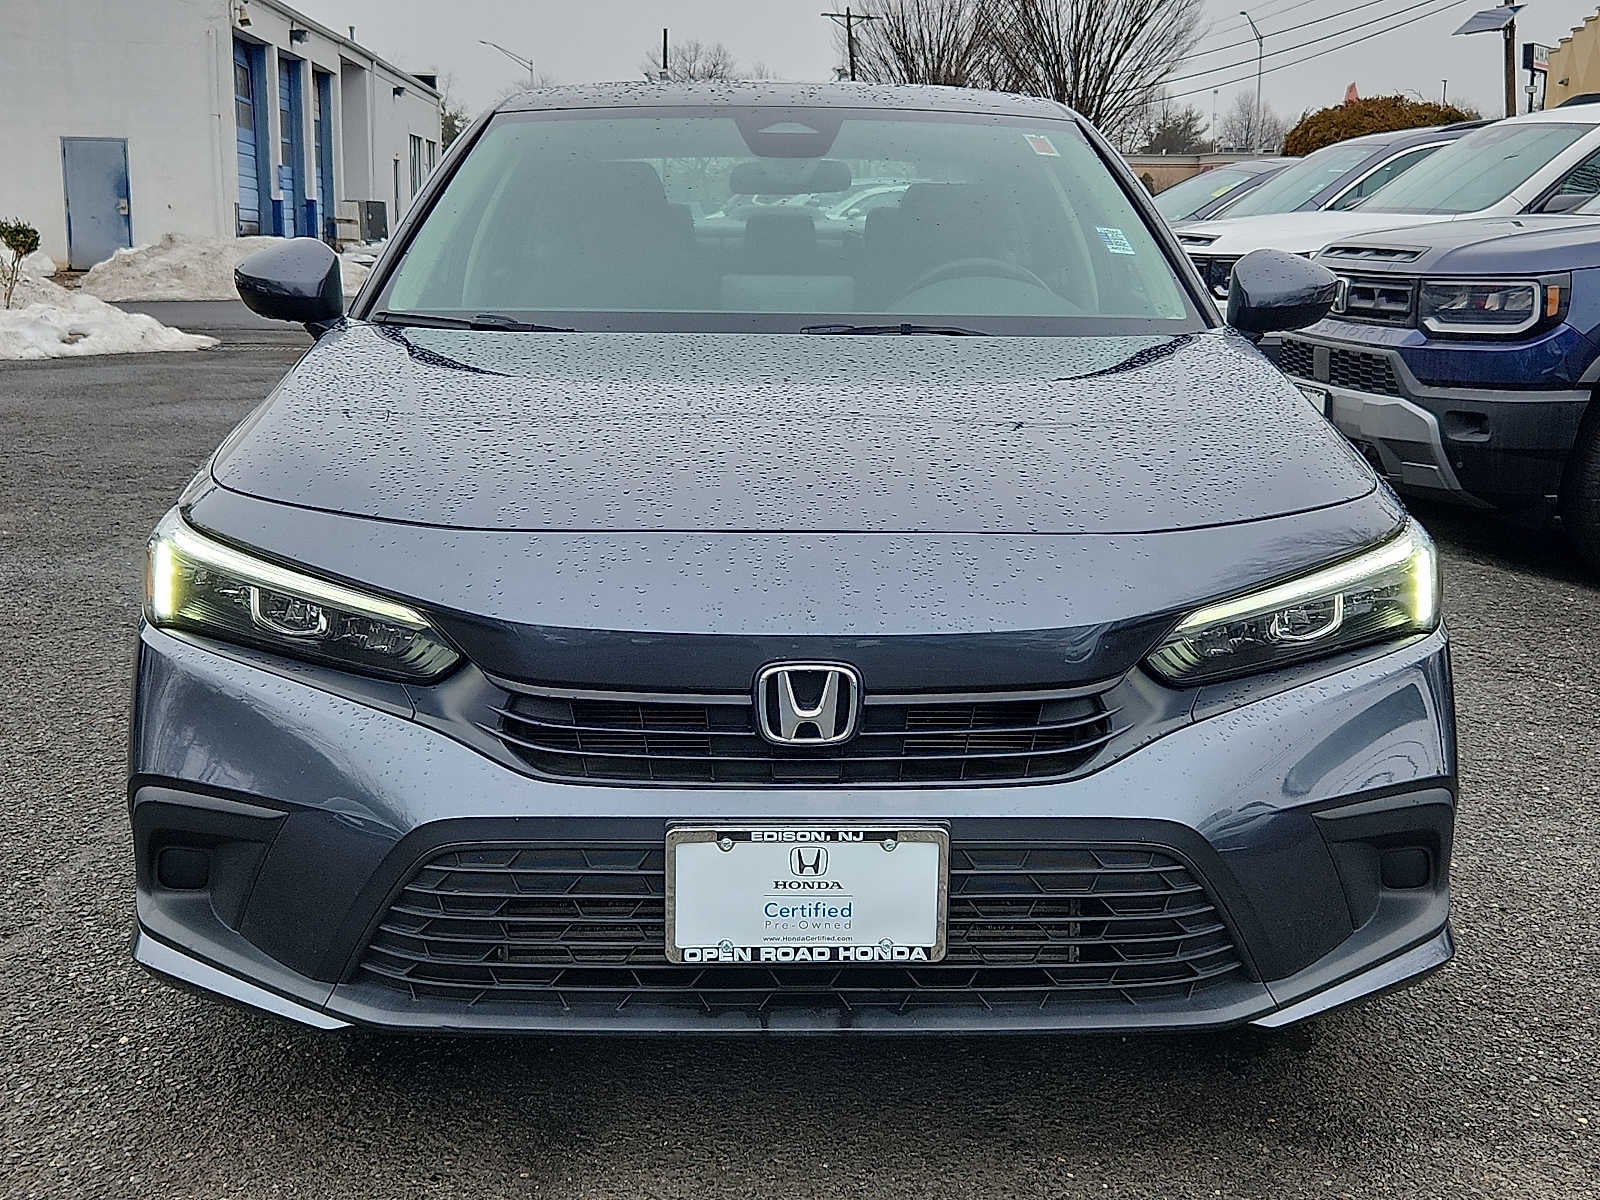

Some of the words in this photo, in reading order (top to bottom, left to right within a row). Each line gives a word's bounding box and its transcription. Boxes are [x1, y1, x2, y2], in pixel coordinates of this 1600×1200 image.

[751, 831, 831, 842] EDISON,
[838, 831, 864, 842] NJ
[773, 880, 844, 890] HONDA
[764, 902, 852, 918] Certified
[764, 920, 852, 930] Pre-Owned
[763, 935, 853, 943] www.HondaCertified.com
[684, 948, 750, 962] OPEN
[760, 948, 831, 962] ROAD
[838, 947, 928, 961] HONDA
